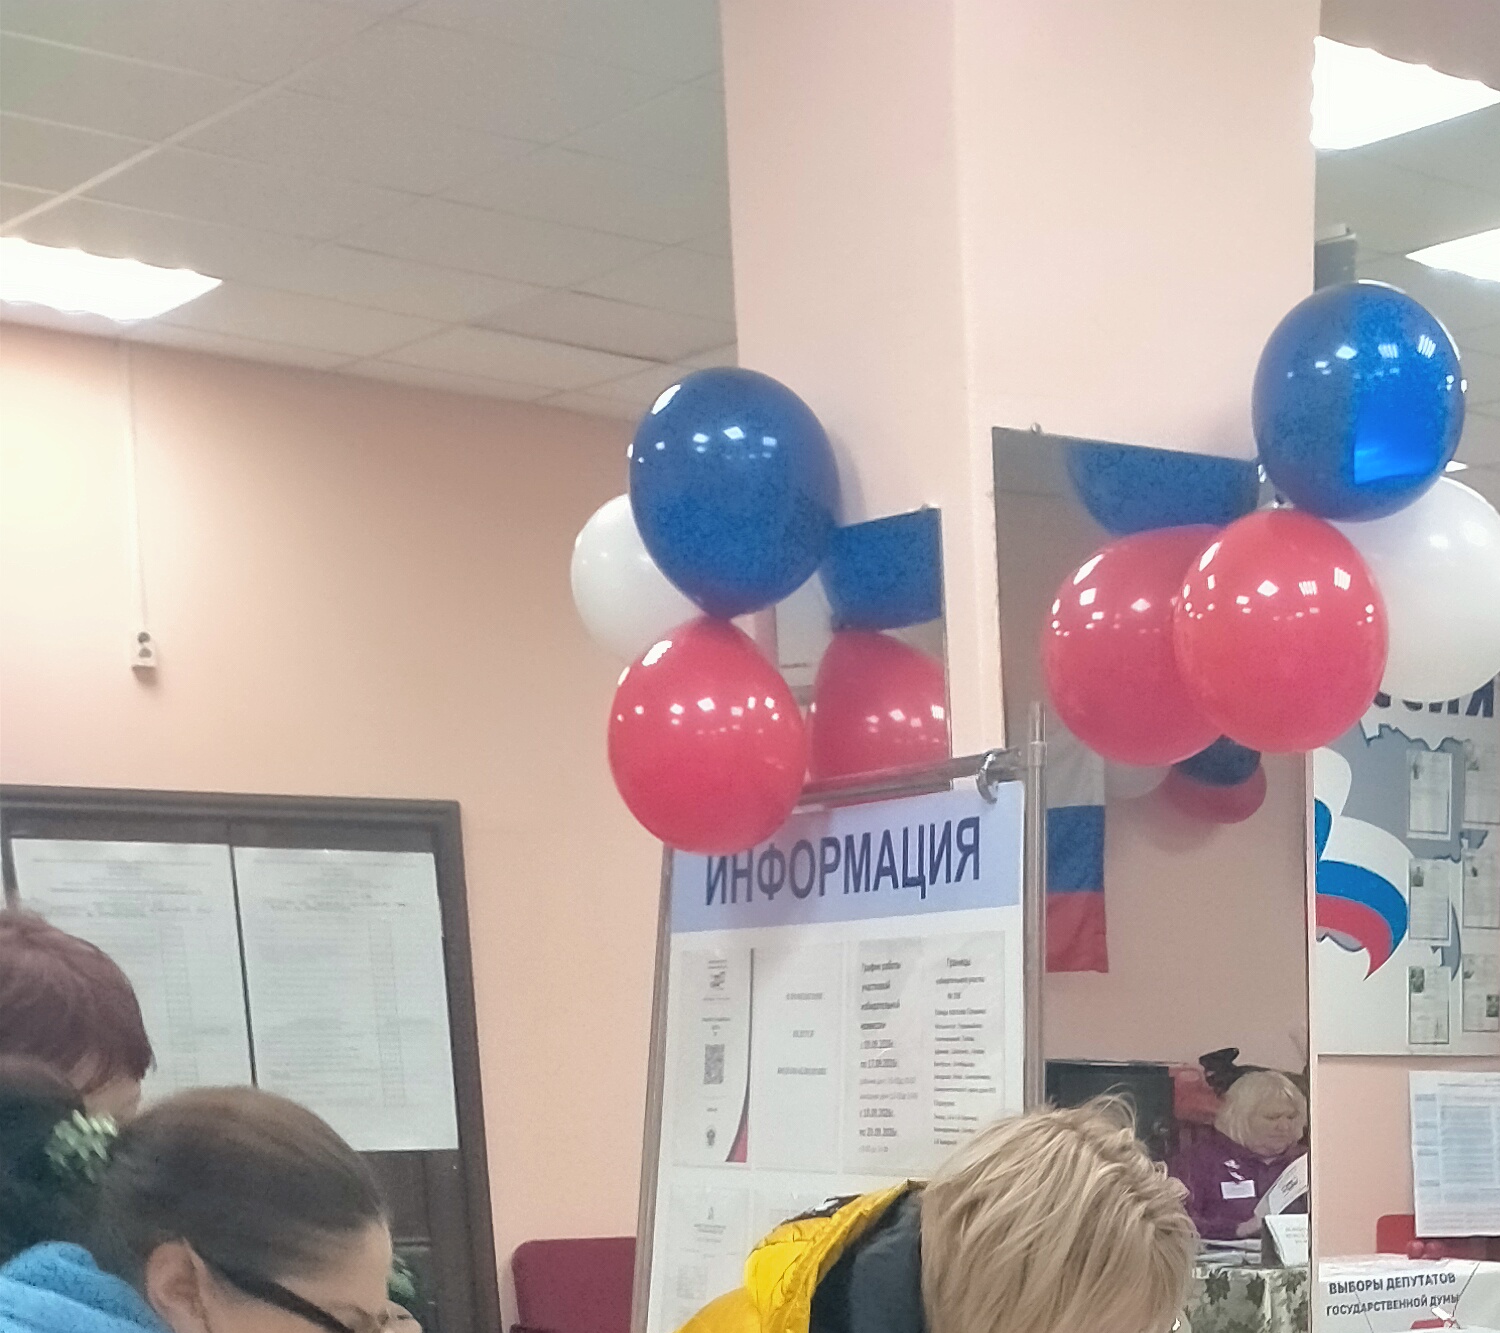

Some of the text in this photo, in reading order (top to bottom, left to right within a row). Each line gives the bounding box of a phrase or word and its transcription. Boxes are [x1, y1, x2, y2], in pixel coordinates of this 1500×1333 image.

[706, 816, 981, 906] ИНФОРМАЦИЯ
[1329, 1272, 1456, 1295] ВЫБОРЫ ДЕПУТАТОВ
[1326, 1294, 1460, 1317] ГОСУДАРСТВЕННОЙ ДУМЫ
